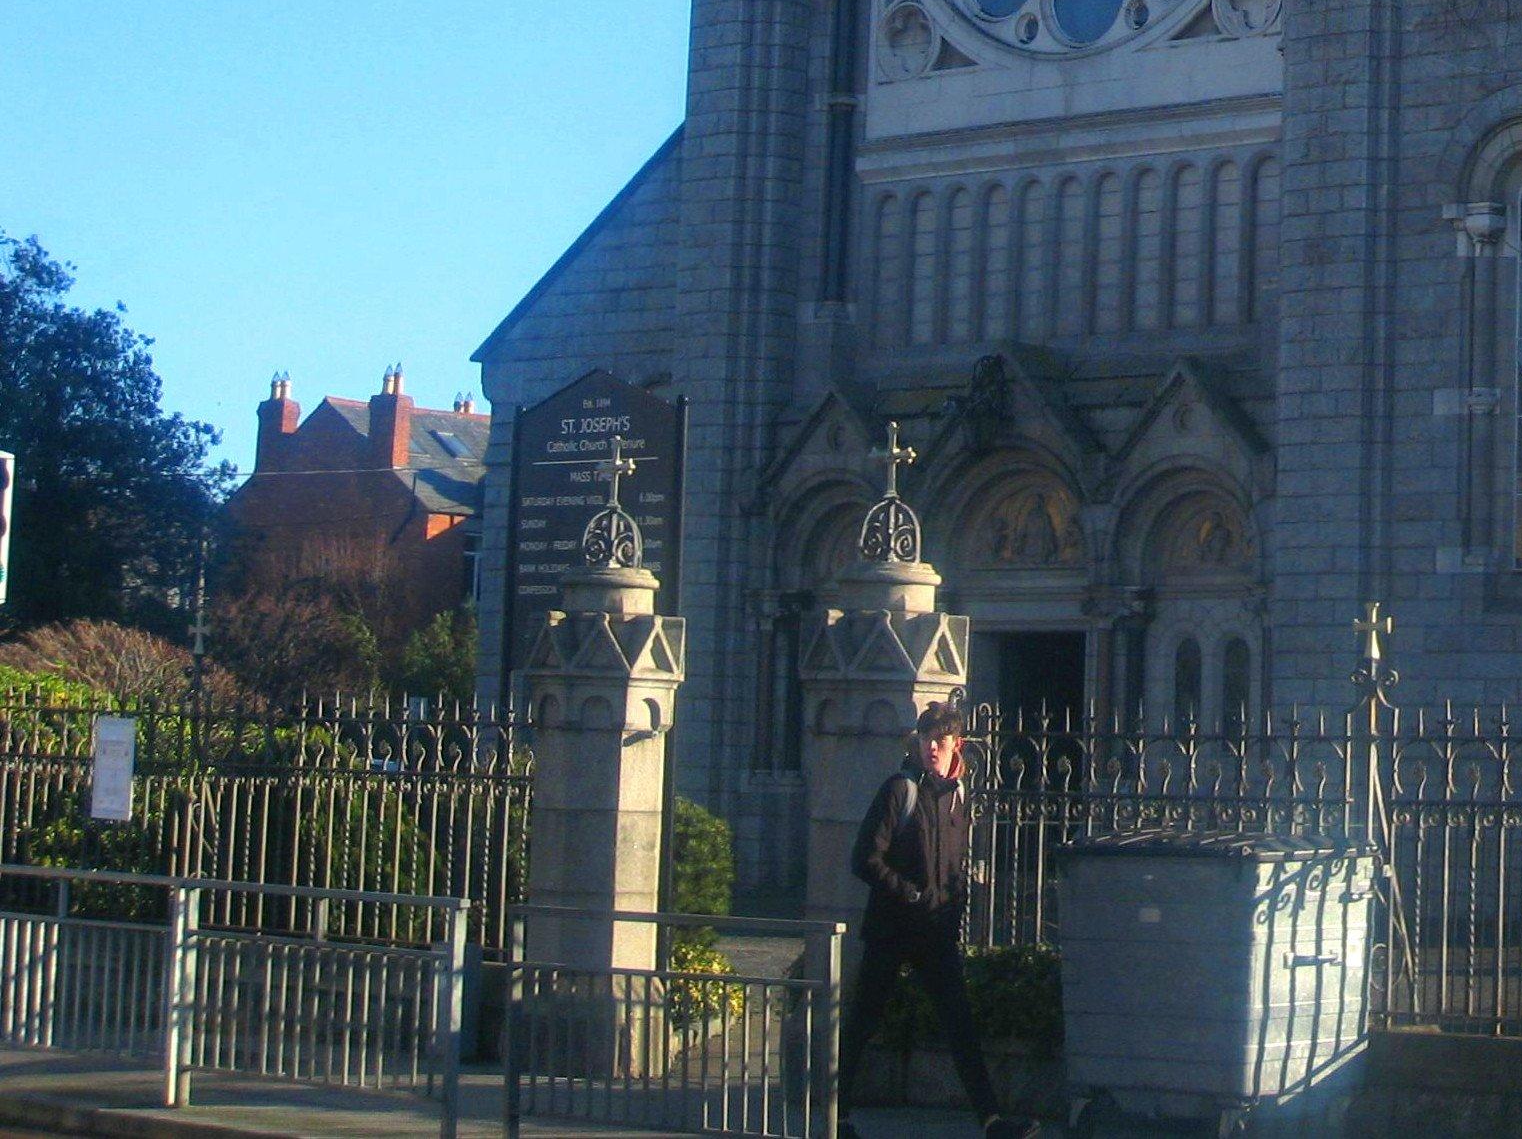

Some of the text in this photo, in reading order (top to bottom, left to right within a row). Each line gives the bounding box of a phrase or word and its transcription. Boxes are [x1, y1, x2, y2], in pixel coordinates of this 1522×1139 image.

[561, 415, 631, 435] ST. JOSEPH'S
[546, 441, 579, 453] Catholic
[579, 439, 608, 452] Church
[570, 471, 592, 483] MASS
